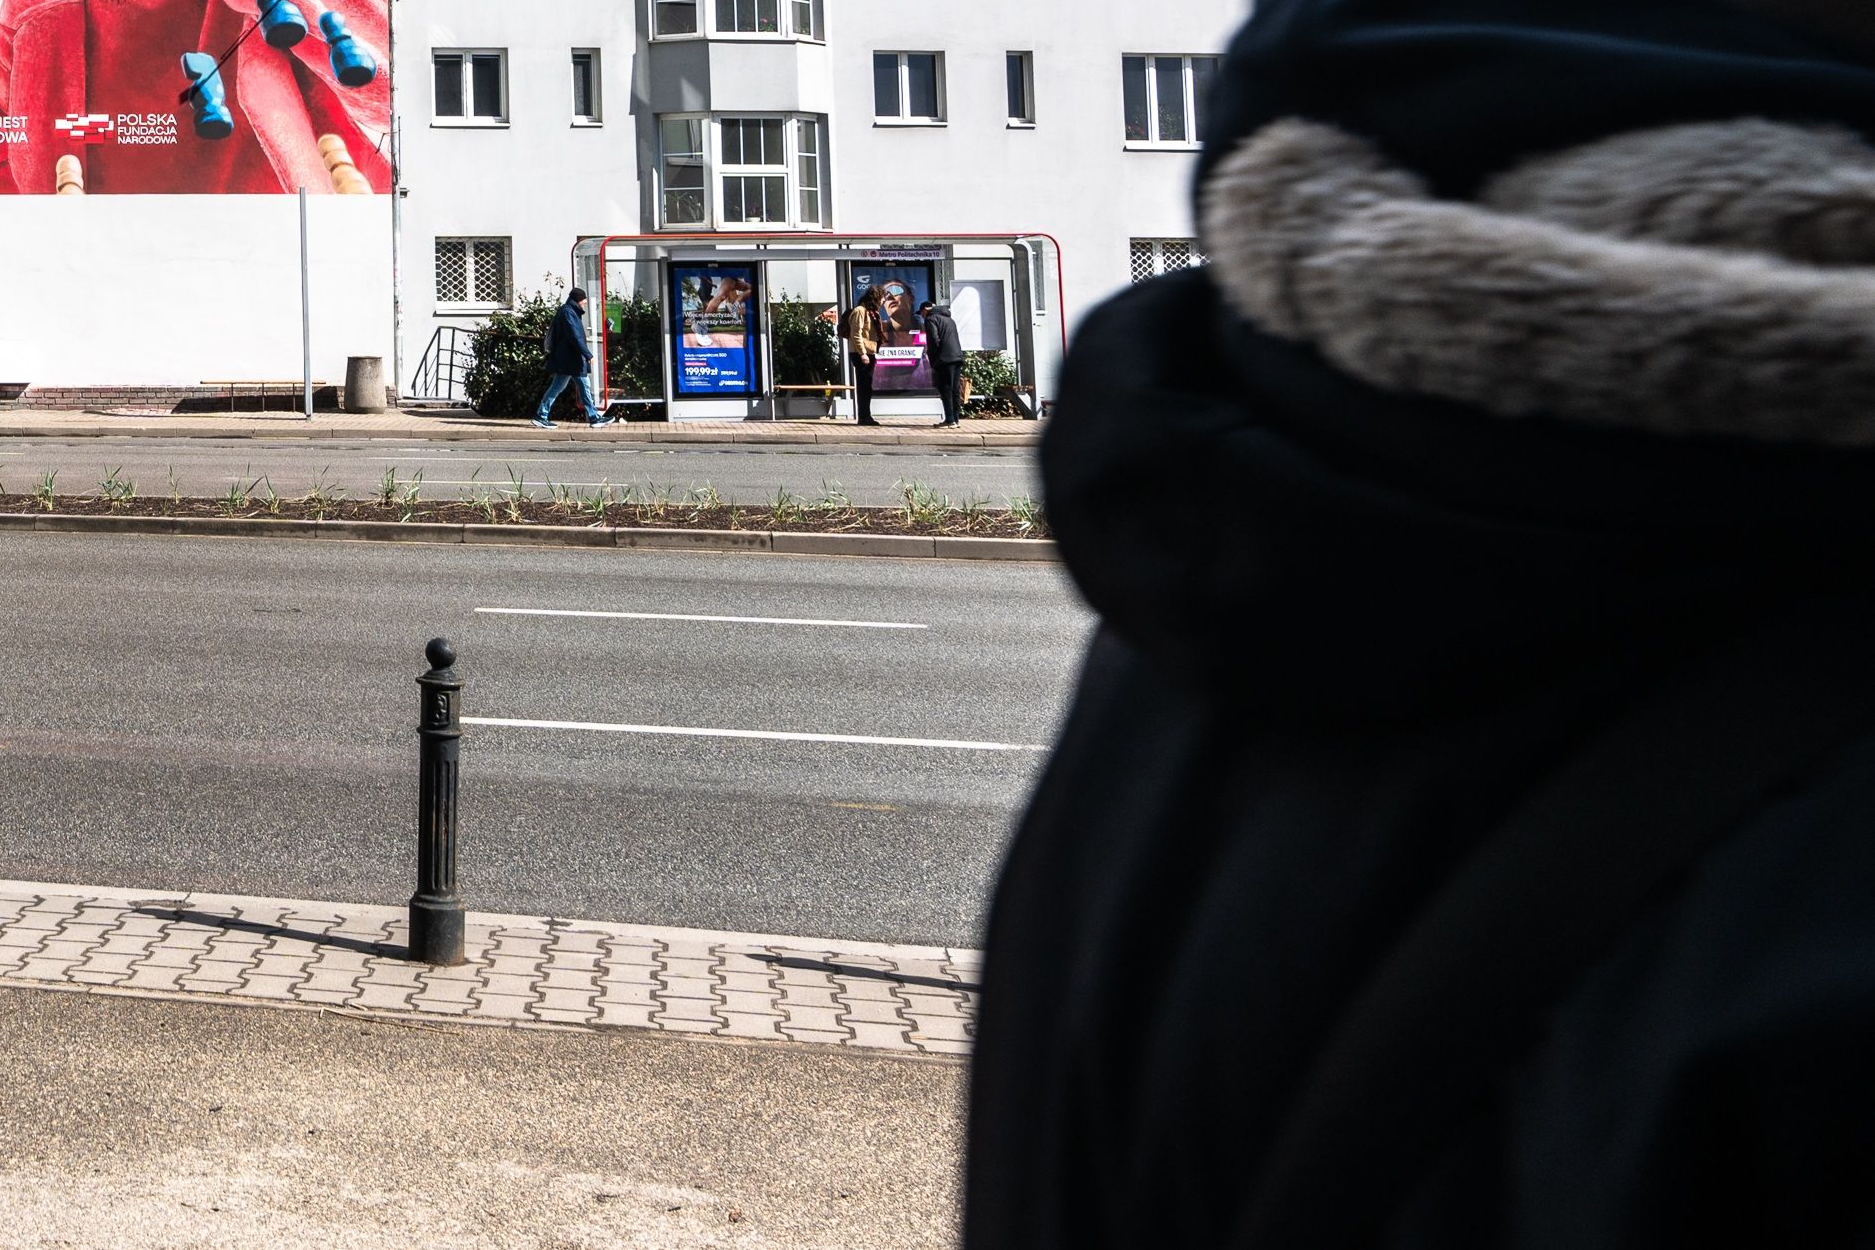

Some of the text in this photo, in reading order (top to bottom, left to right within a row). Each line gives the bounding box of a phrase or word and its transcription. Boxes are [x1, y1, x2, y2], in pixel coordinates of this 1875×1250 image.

[117, 113, 178, 126] POLSKA
[117, 125, 178, 136] FUNDACJA
[117, 135, 178, 145] NARODOWA
